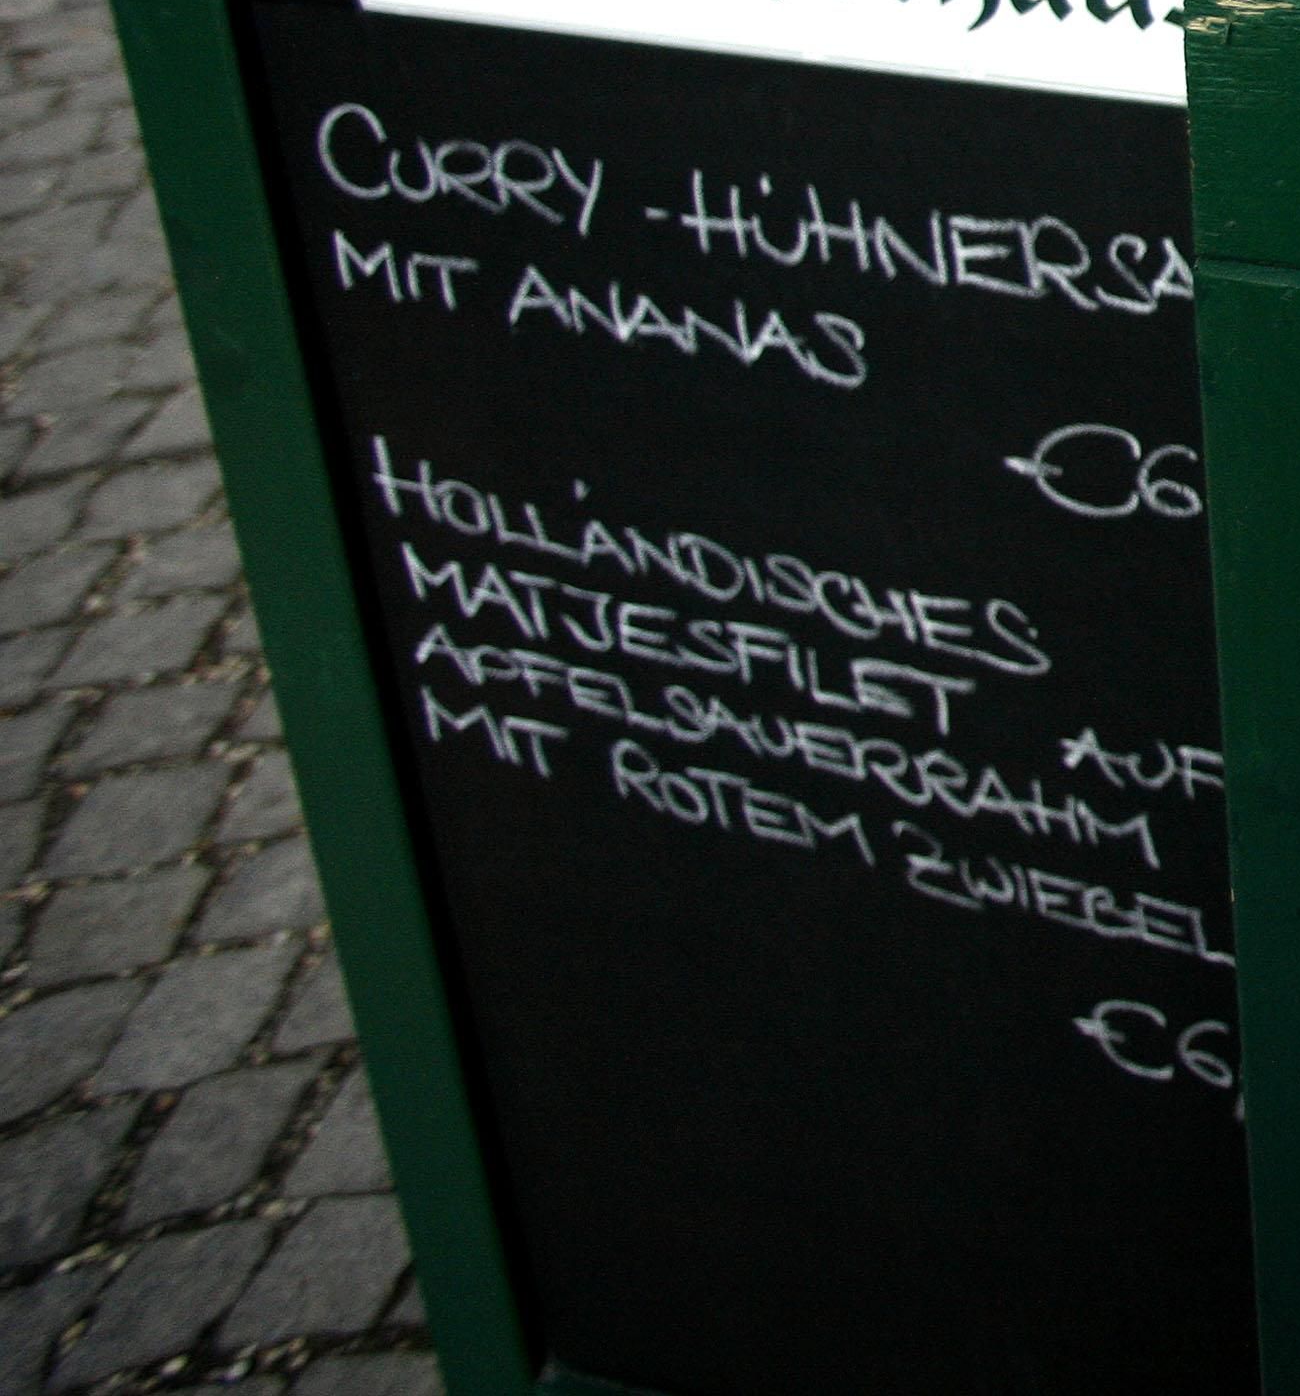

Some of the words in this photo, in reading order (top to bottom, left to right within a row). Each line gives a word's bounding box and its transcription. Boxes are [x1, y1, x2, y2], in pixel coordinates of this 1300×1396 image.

[316, 101, 602, 237] CURRY
[329, 228, 481, 311] MIT
[507, 264, 868, 391] ANANAS
[399, 540, 977, 736] MATJESFILET
[1057, 726, 1226, 799] AUF
[414, 622, 1162, 871] APFELSAUERRAHM
[417, 685, 570, 780] MIT
[610, 737, 877, 868] ROTEM
